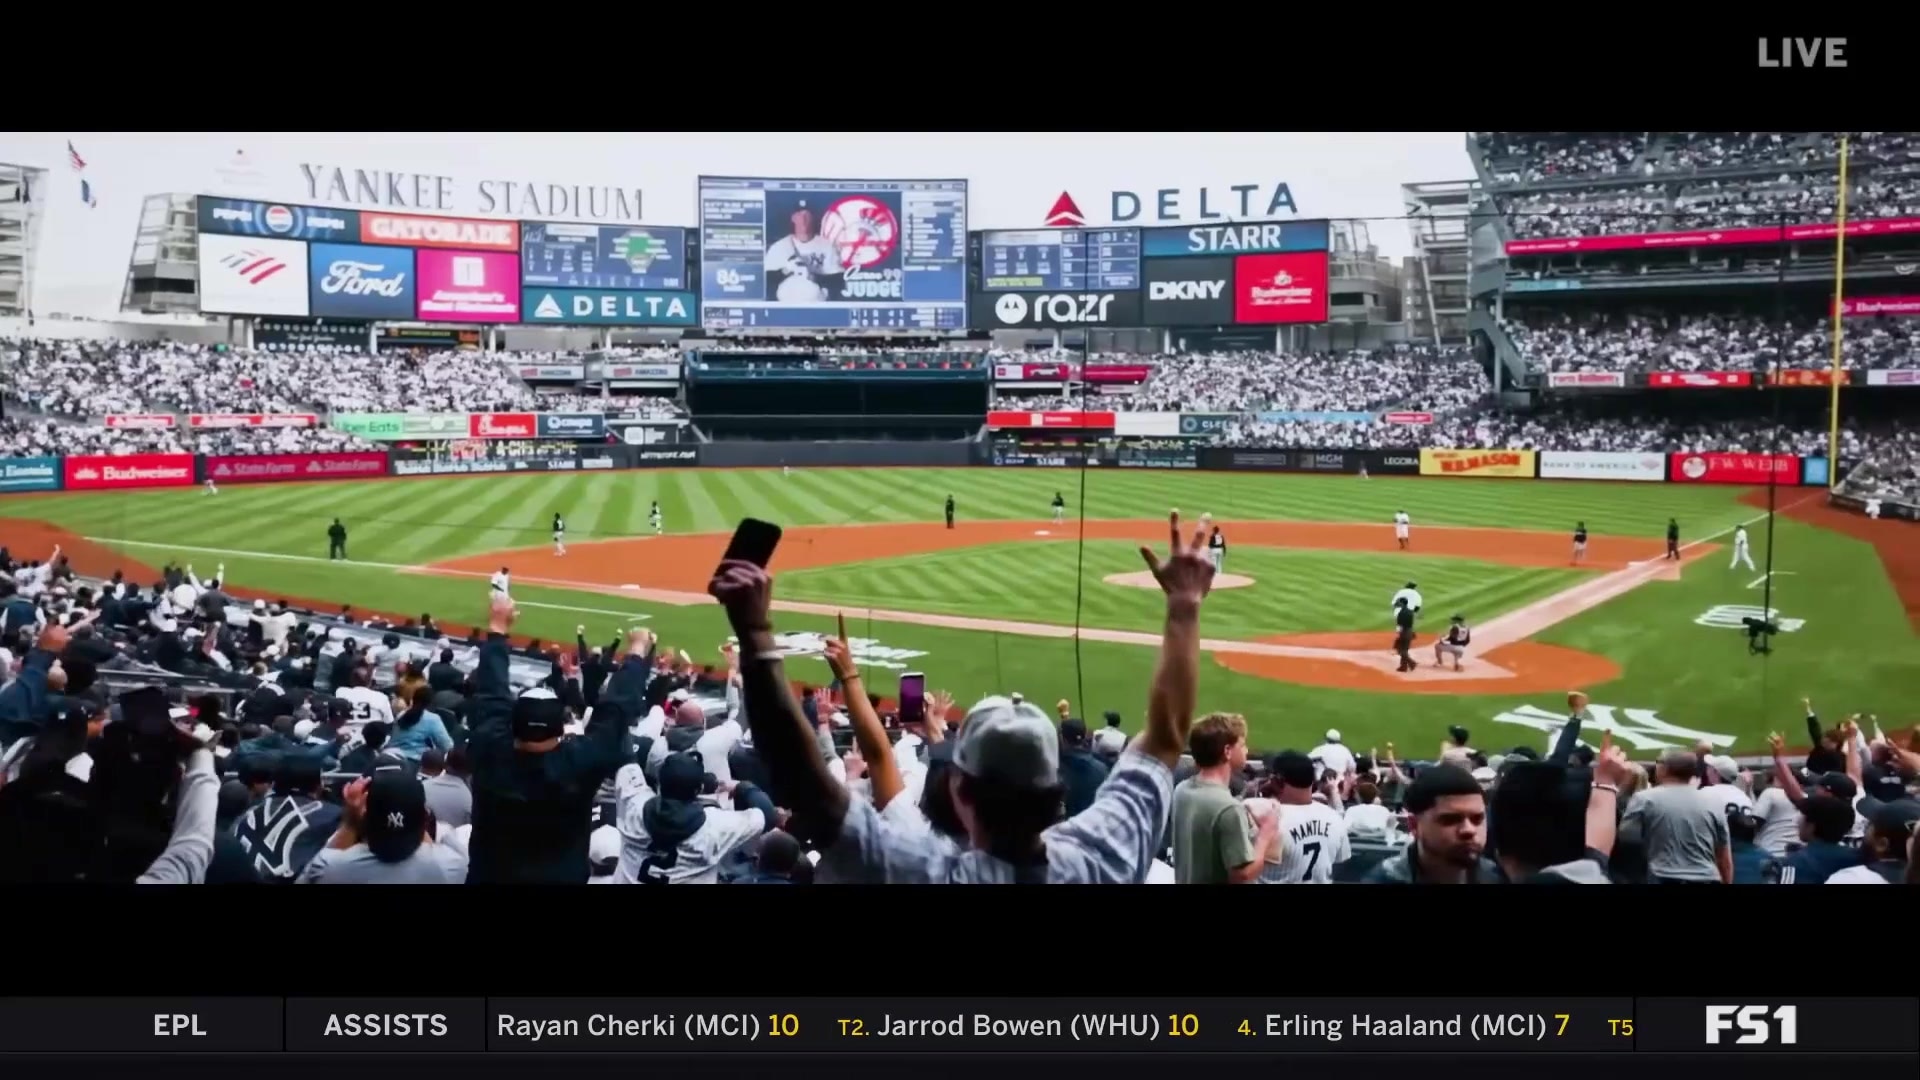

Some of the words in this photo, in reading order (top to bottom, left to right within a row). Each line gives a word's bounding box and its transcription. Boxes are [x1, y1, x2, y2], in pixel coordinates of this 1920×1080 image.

[300, 163, 454, 211] YANKEE
[478, 179, 643, 221] STADIUM
[1111, 182, 1299, 222] DELTA
[370, 217, 513, 245] GATORADE
[1188, 224, 1282, 252] STARR
[320, 260, 405, 297] Ford
[841, 281, 902, 298] JUDGE
[1149, 280, 1226, 300] DKNY
[573, 295, 687, 318] DELTA
[1034, 294, 1115, 322] razr
[369, 421, 400, 433] Eats
[103, 466, 188, 480] Budweiser
[387, 810, 405, 828] NY
[1289, 820, 1331, 844] MANTLE
[1302, 841, 1321, 881] 7
